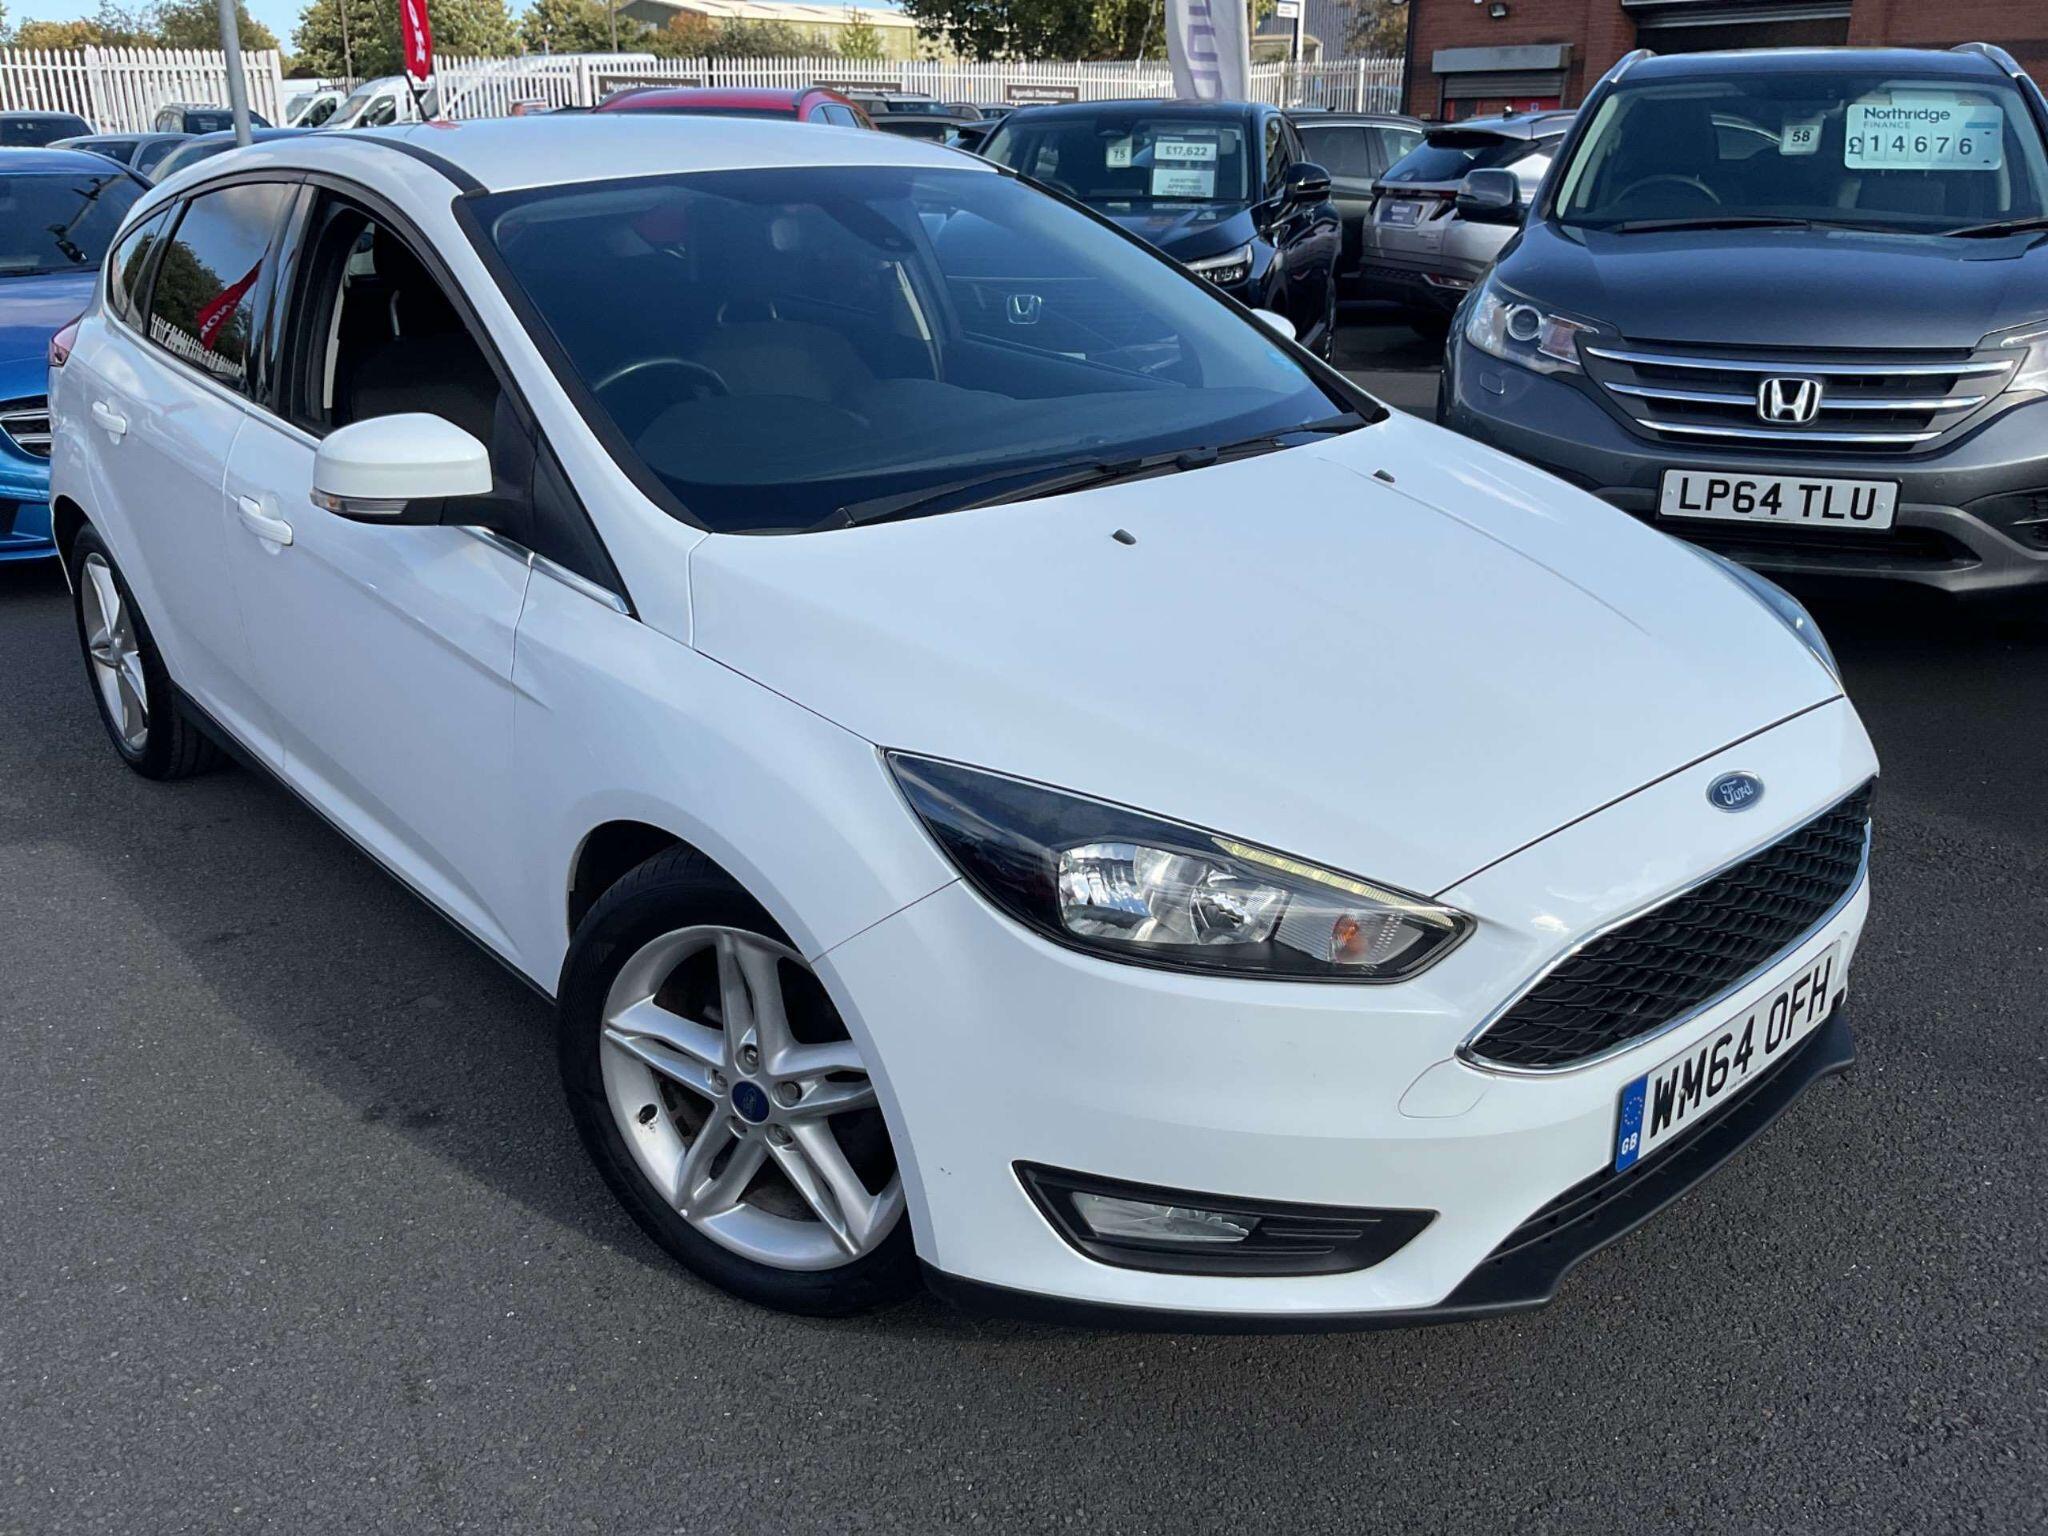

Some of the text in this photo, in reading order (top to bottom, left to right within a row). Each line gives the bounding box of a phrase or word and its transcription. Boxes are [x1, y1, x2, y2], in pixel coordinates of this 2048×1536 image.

[1864, 106, 1952, 123] Northridge
[1863, 121, 1911, 129] FINANCE
[1792, 130, 1810, 142] 58
[1112, 150, 1126, 159] 75
[1165, 146, 1208, 157] £17,622
[1679, 477, 1877, 520] LP64 TLU
[1720, 779, 1754, 805] Ford
[1650, 956, 1832, 1139] WM64 OFH
[1621, 1132, 1639, 1156] GB
